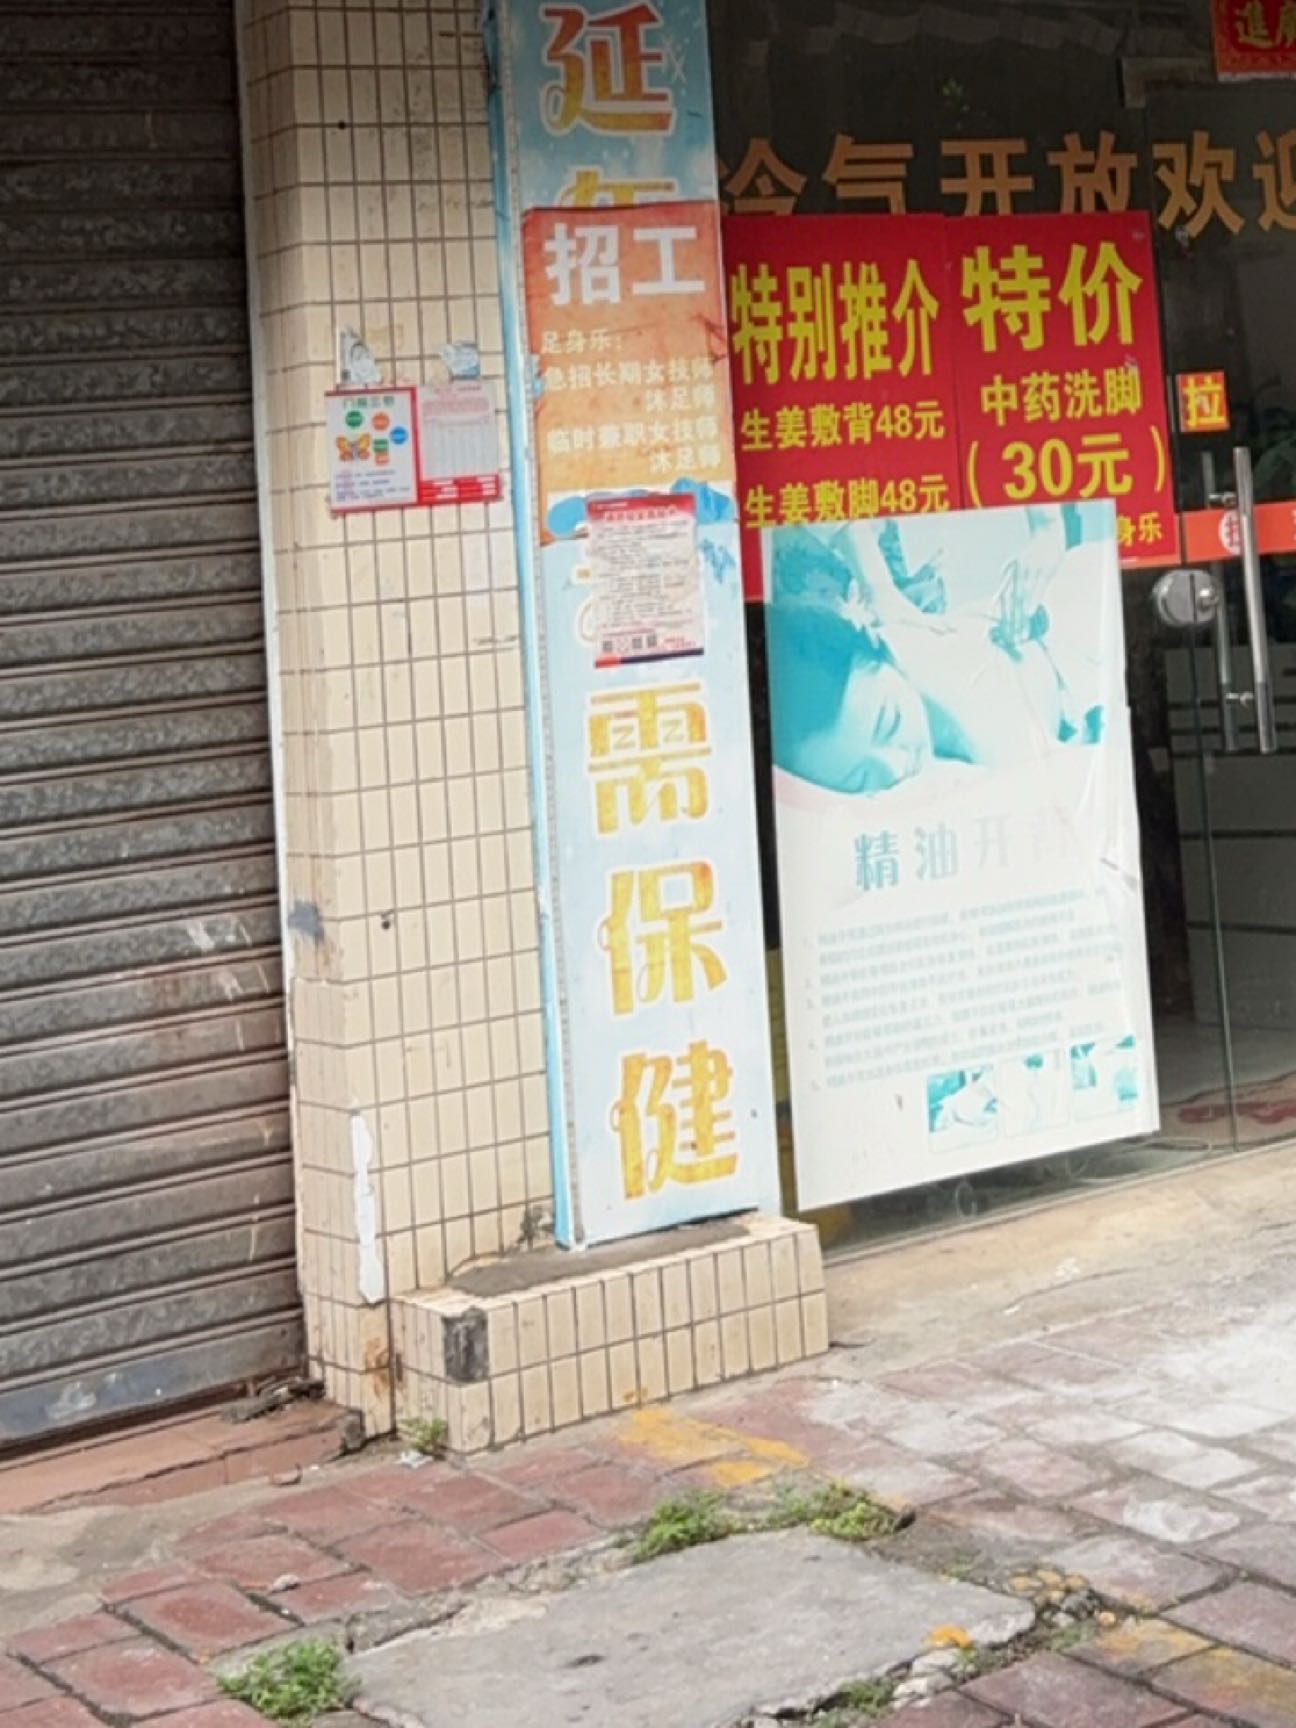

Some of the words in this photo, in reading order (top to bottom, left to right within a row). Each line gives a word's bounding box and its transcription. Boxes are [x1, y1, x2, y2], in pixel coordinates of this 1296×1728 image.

[544, 222, 706, 306] 招工
[960, 242, 1143, 353] 特价
[731, 258, 939, 385] 特别推介
[740, 399, 946, 453] 生姜敷背48元
[980, 365, 1142, 427] 中药洗脚
[745, 473, 951, 529] 生姜敷脚48元
